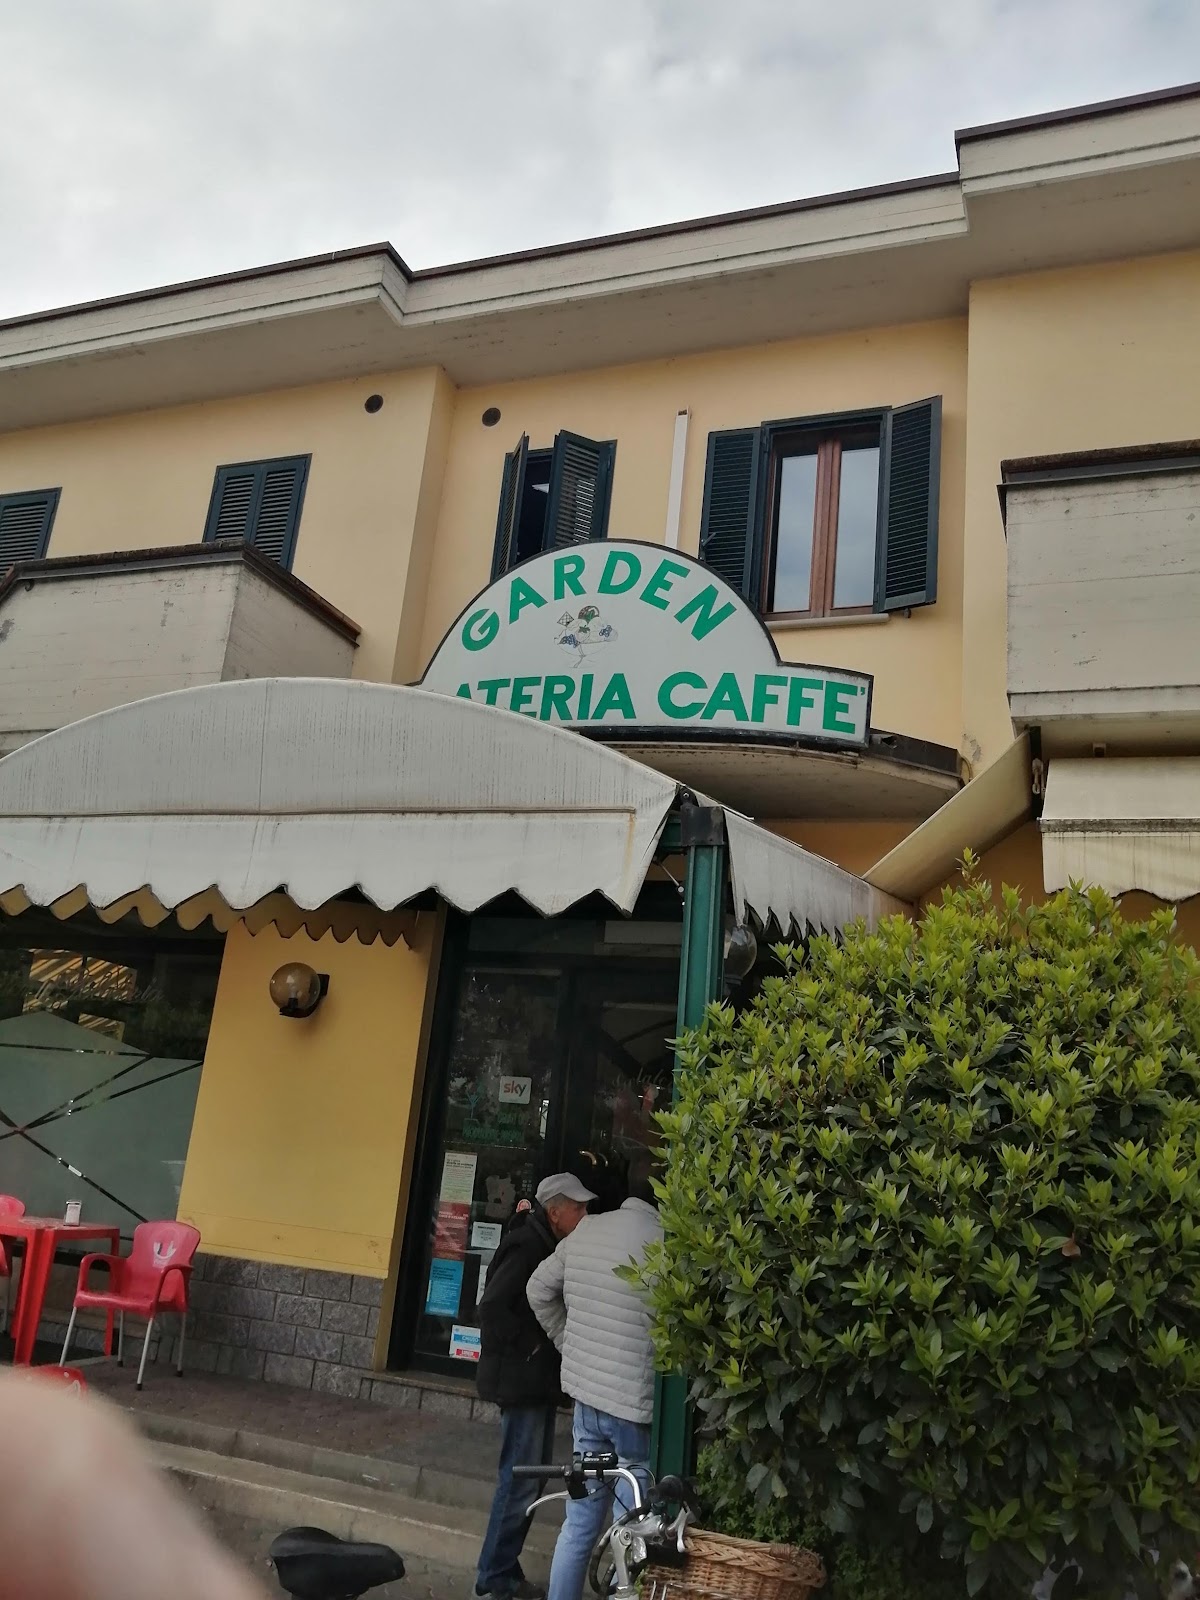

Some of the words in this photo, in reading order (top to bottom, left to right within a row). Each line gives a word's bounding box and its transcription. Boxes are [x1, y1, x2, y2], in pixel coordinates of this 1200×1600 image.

[461, 550, 737, 652] GARDEN
[657, 671, 867, 735] CAFFE'
[503, 1080, 527, 1097] sky
